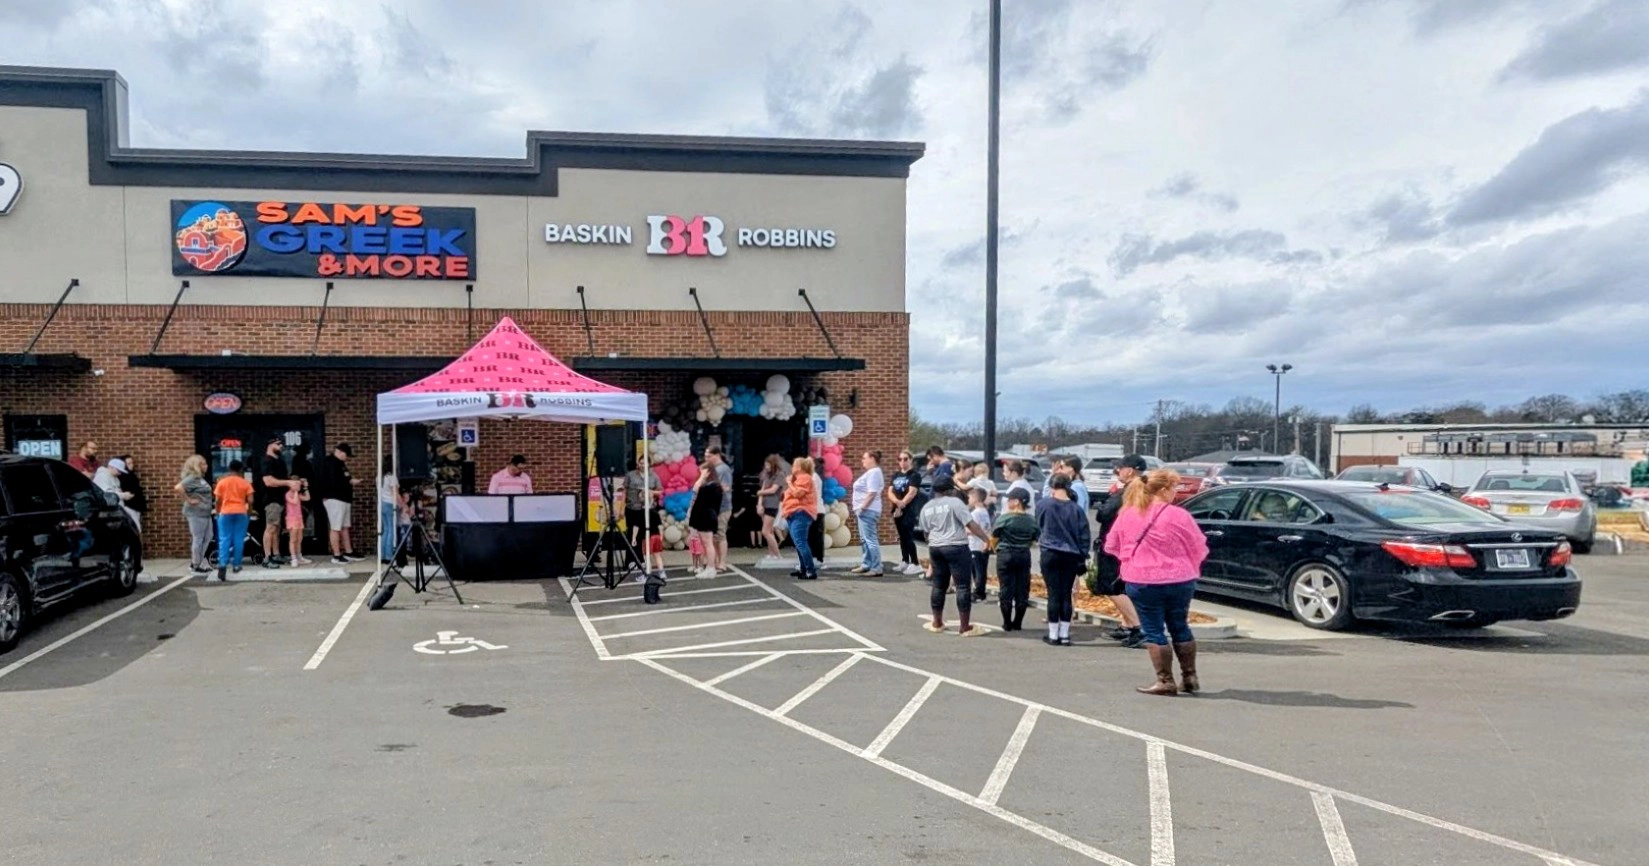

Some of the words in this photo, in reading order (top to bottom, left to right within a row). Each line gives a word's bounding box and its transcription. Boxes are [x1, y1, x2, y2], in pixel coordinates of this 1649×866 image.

[256, 202, 423, 227] SAM'S
[256, 225, 468, 256] GREEK
[545, 223, 632, 245] BASKIN
[738, 228, 837, 248] ROBBINS
[317, 255, 469, 278] &MORE
[207, 396, 237, 409] OPEN
[436, 396, 482, 408] BASKIN
[283, 431, 302, 447] 106
[19, 441, 61, 457] OPEN
